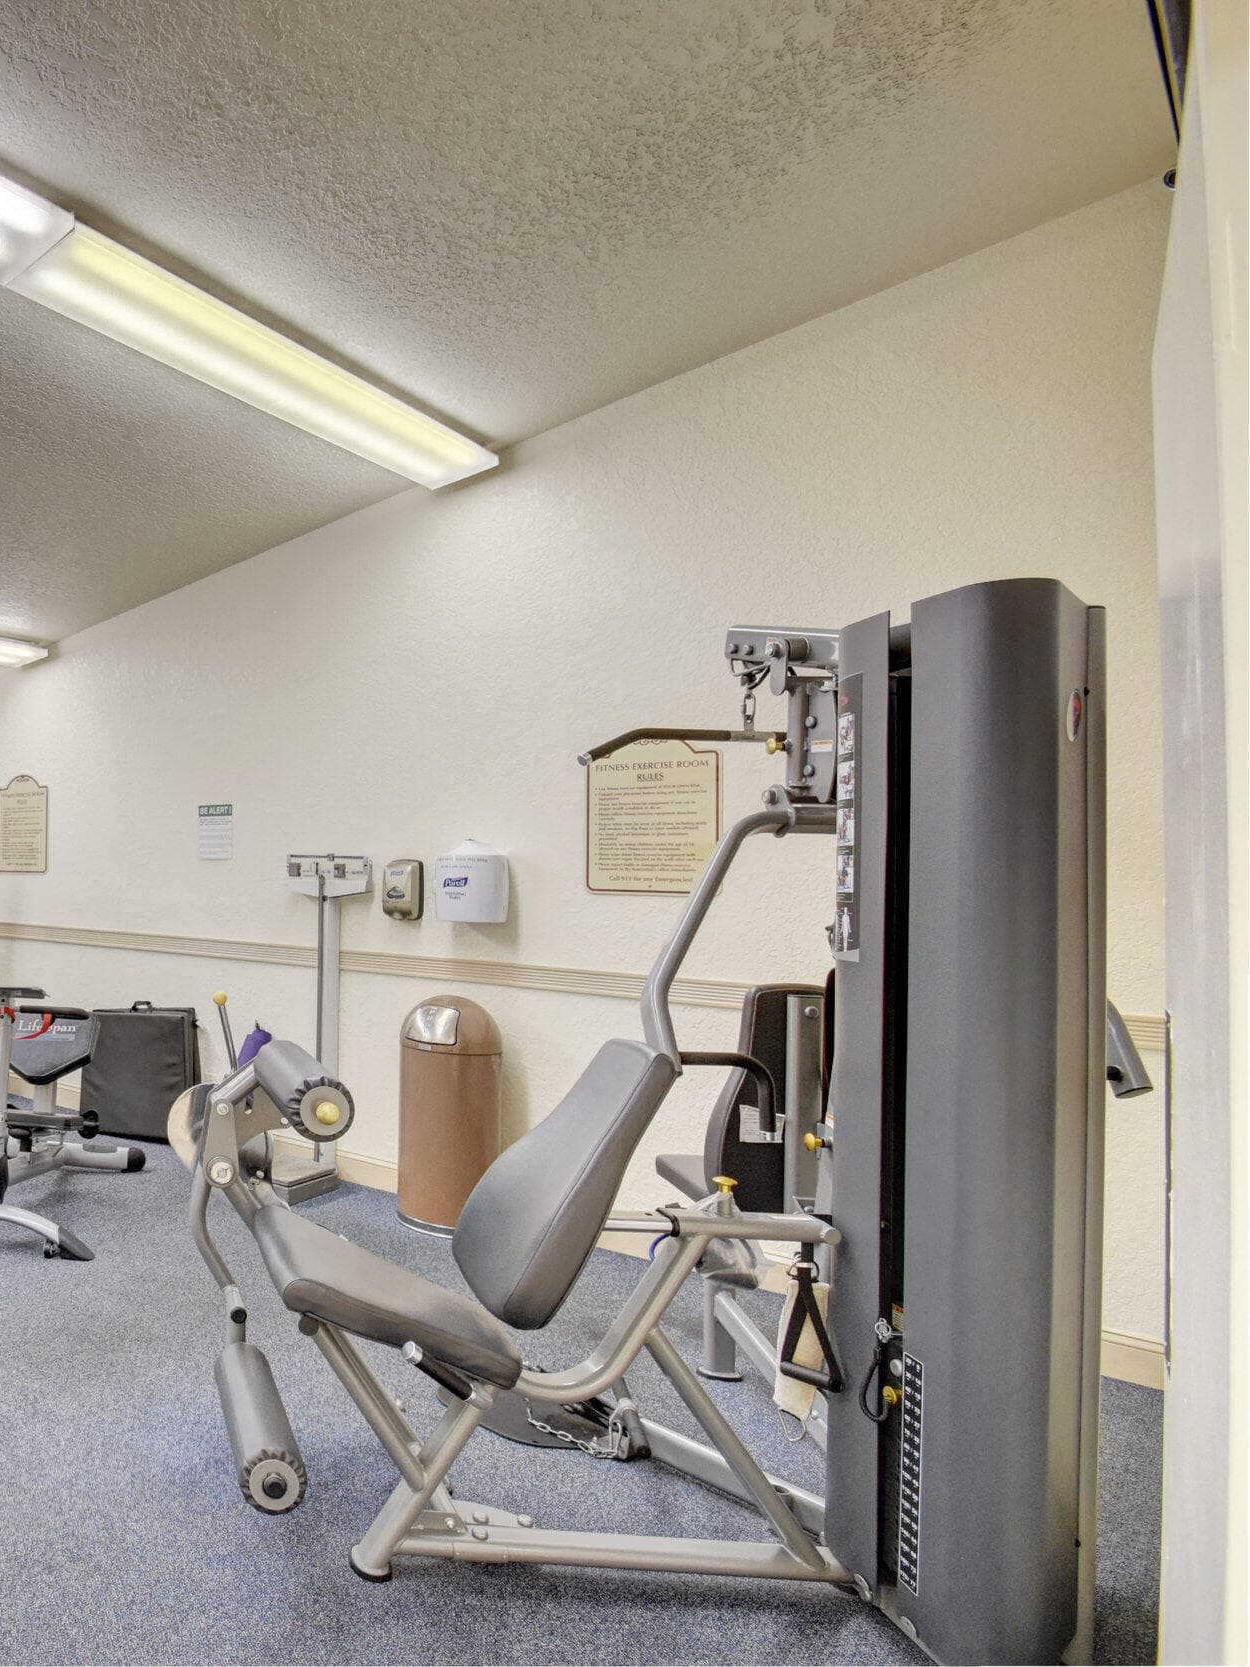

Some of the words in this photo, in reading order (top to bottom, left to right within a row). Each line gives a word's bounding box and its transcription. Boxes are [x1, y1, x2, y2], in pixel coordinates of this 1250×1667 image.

[595, 763, 630, 772] FITNESS
[632, 761, 674, 771] EXERCISE
[676, 759, 709, 768] ROOM
[636, 772, 664, 781] RULES
[200, 807, 208, 815] BE
